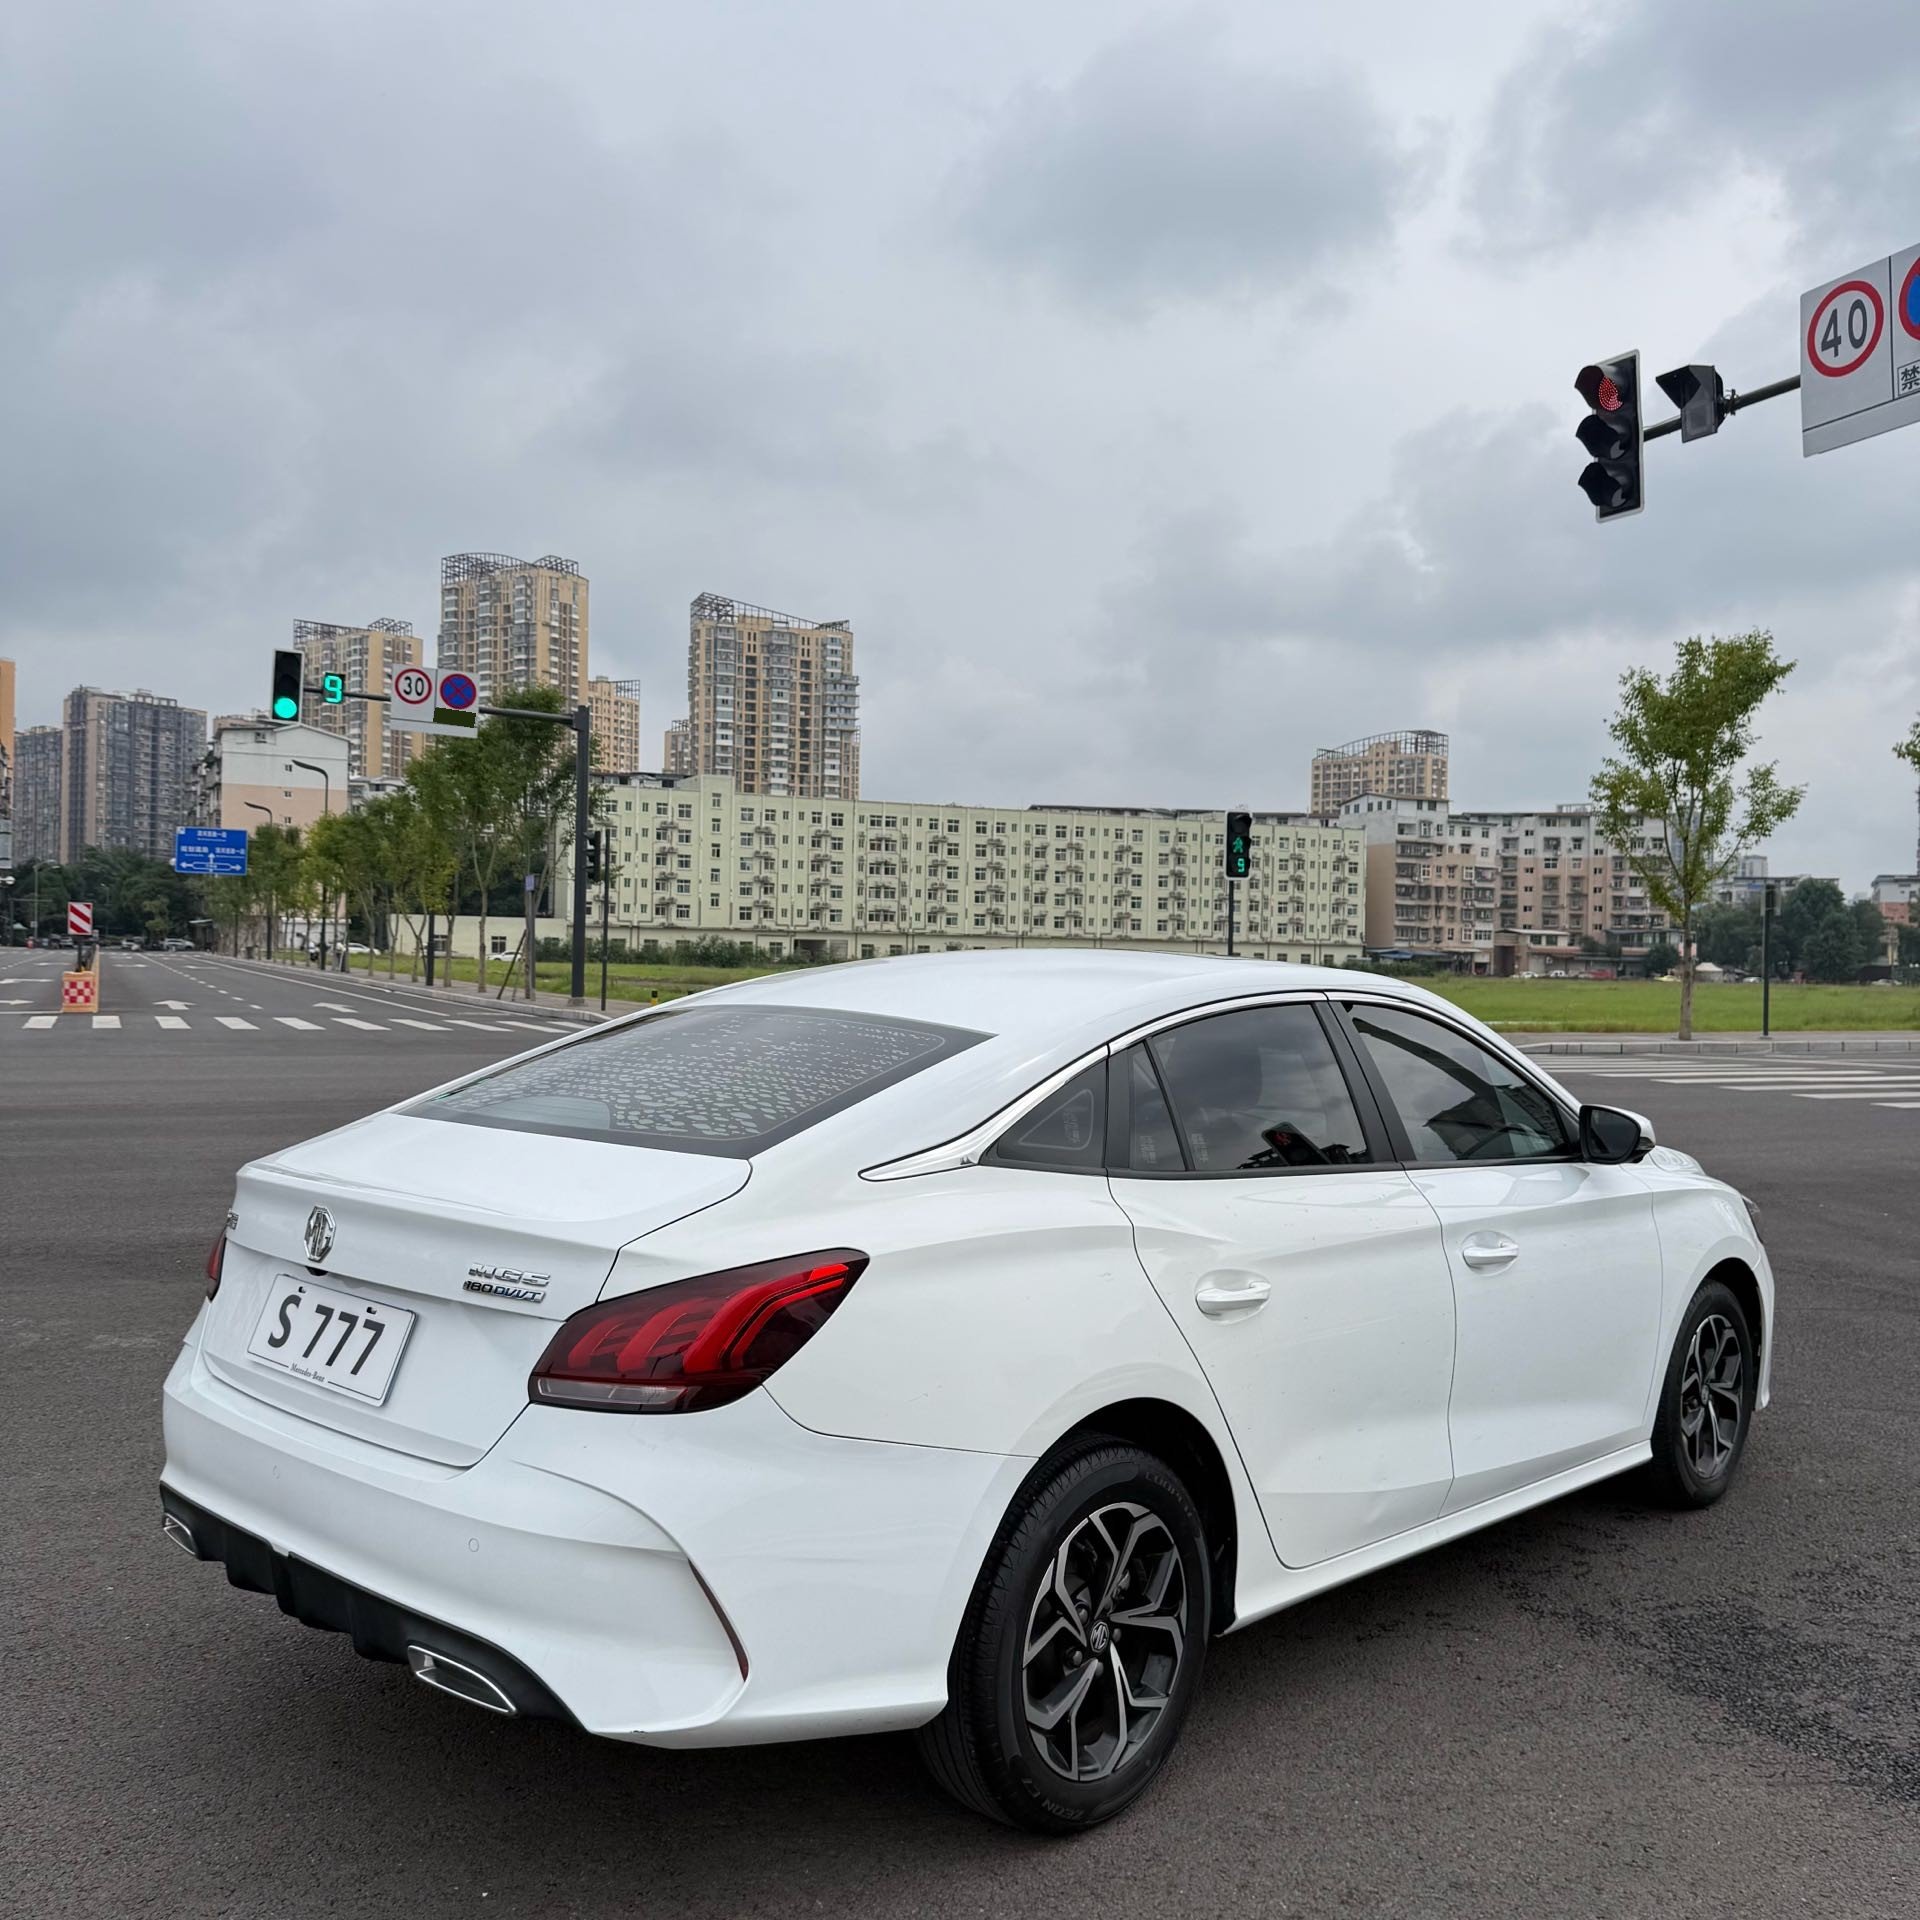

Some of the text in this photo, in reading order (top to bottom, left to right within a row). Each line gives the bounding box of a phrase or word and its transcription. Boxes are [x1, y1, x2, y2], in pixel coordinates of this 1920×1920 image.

[1821, 299, 1868, 358] 40
[324, 674, 343, 704] 9
[403, 676, 425, 697] 30
[1237, 857, 1246, 873] 9
[267, 1294, 386, 1376] S 777
